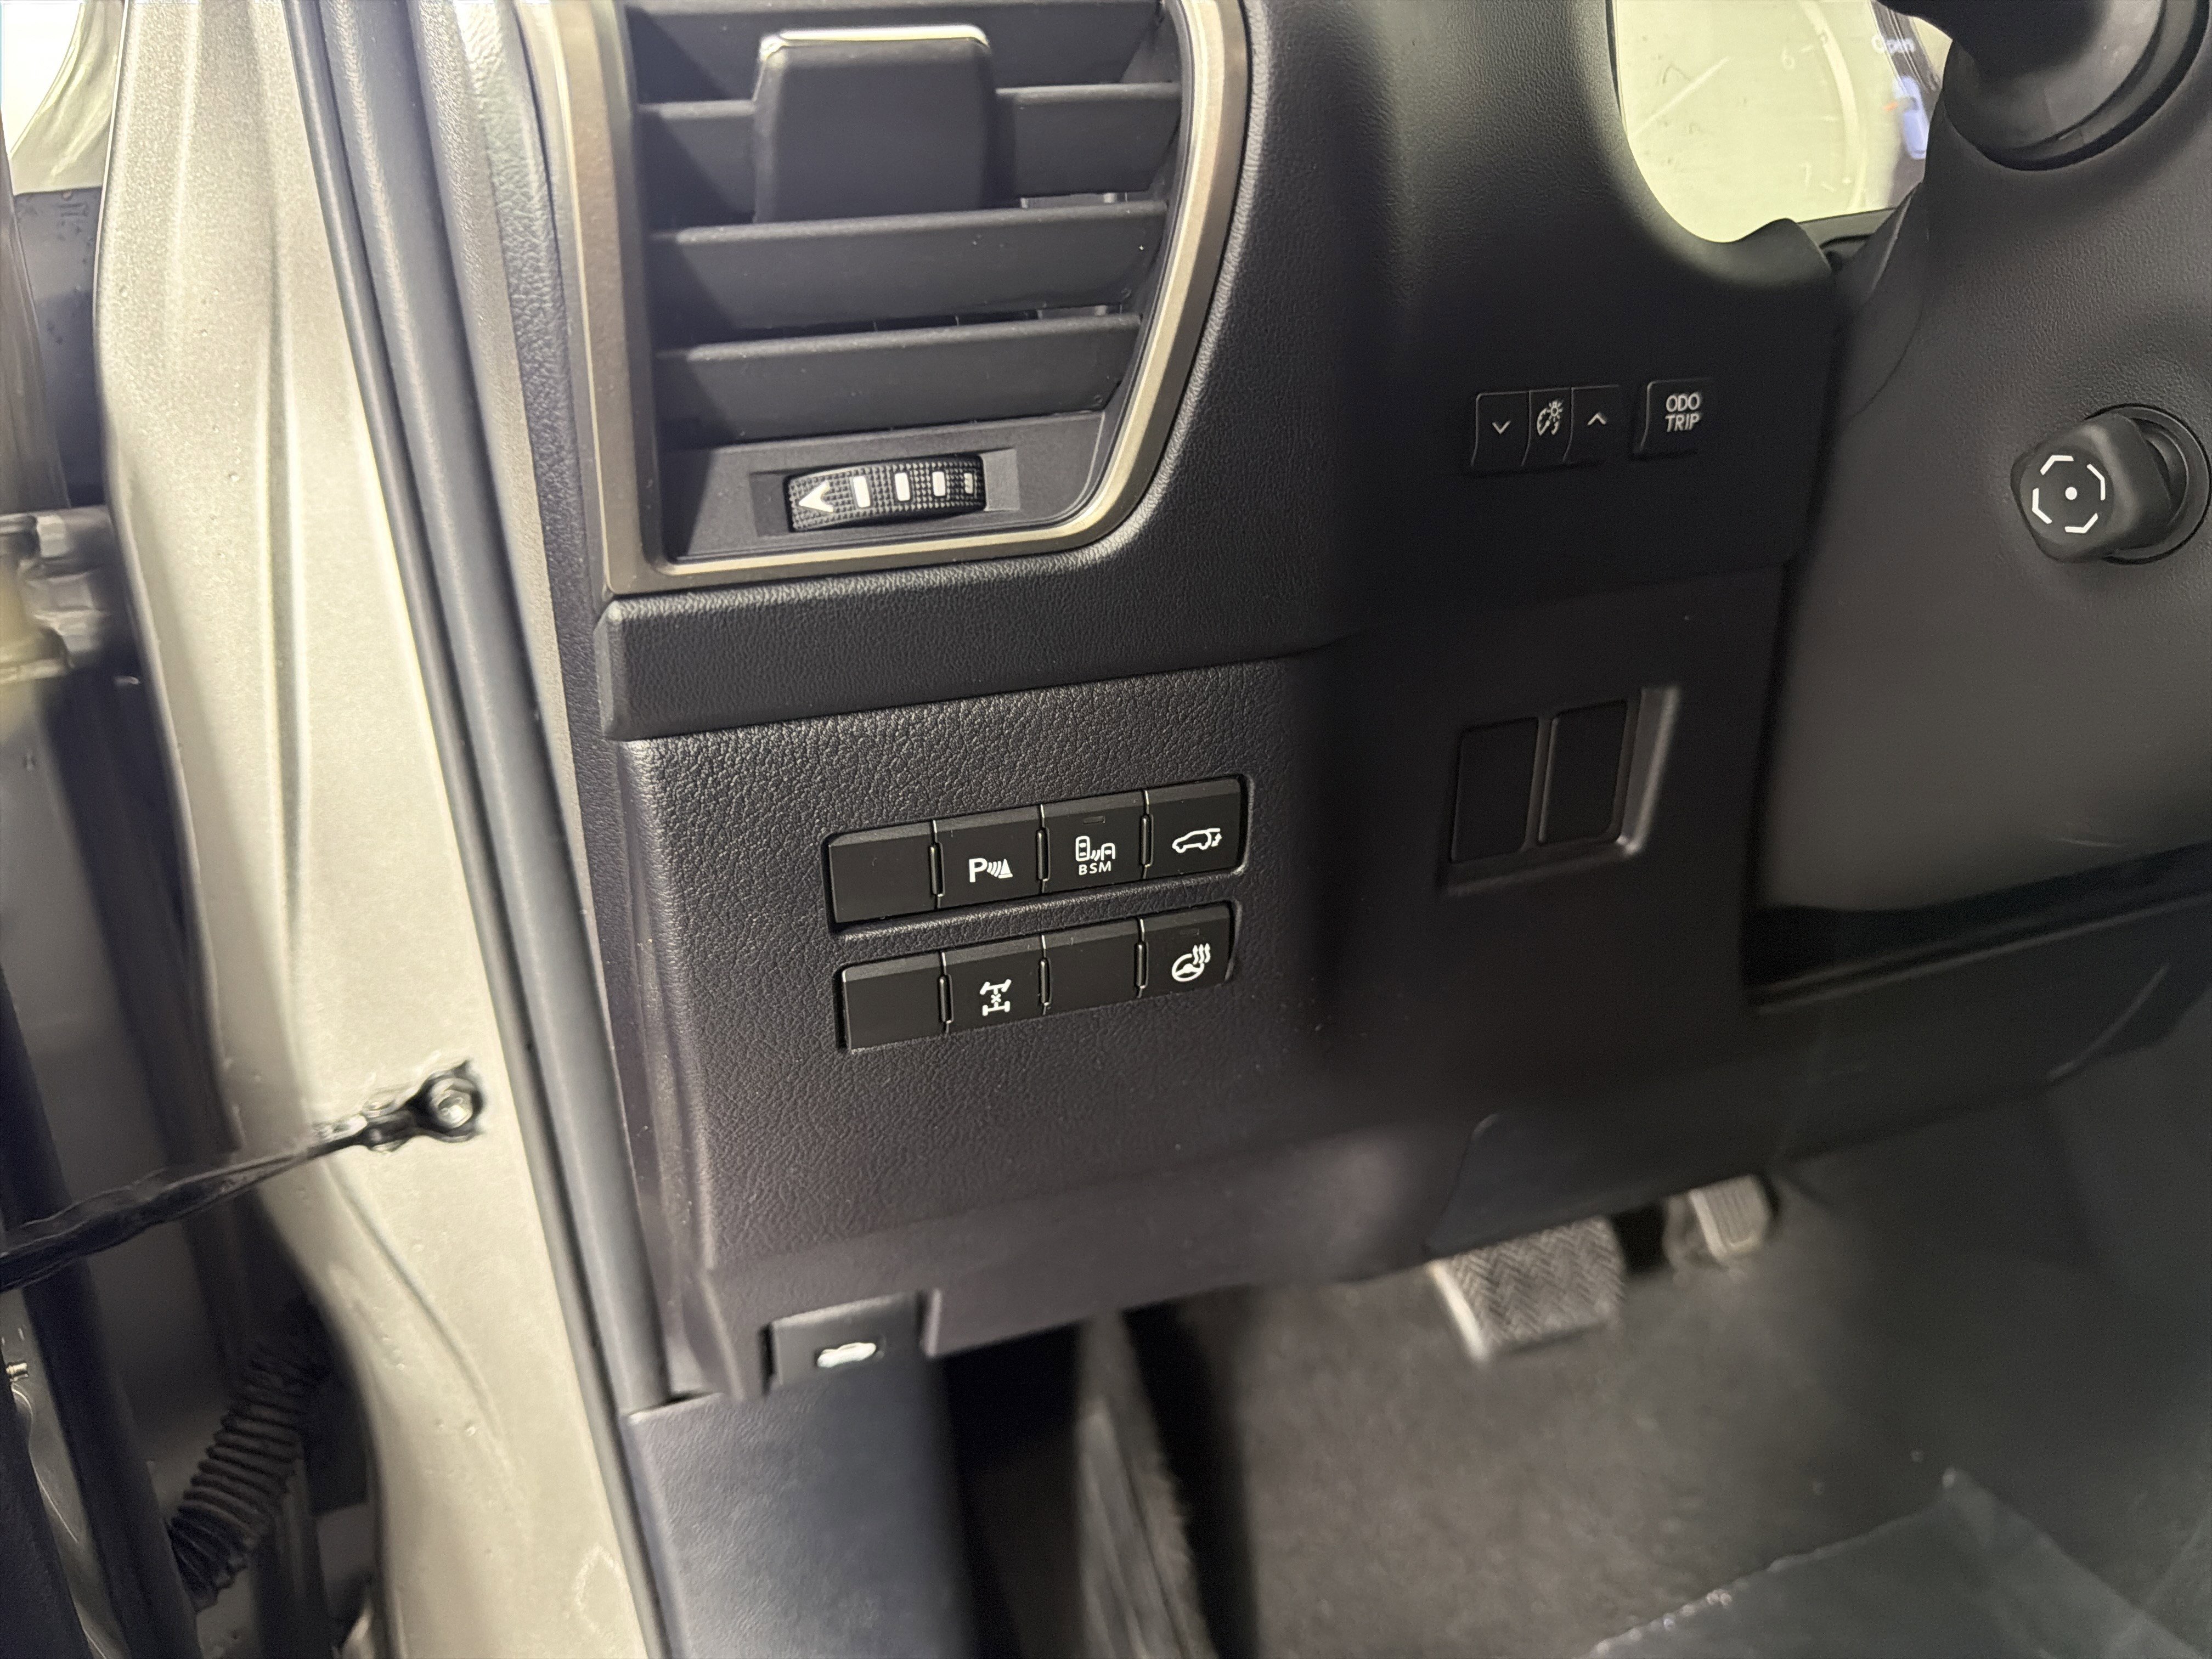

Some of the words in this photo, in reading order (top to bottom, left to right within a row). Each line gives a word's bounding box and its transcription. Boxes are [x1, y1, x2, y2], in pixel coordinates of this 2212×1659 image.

[1666, 392, 1701, 413] ODO
[1665, 413, 1700, 432] TRIP
[969, 857, 986, 883] P
[1079, 861, 1111, 876] BSM
